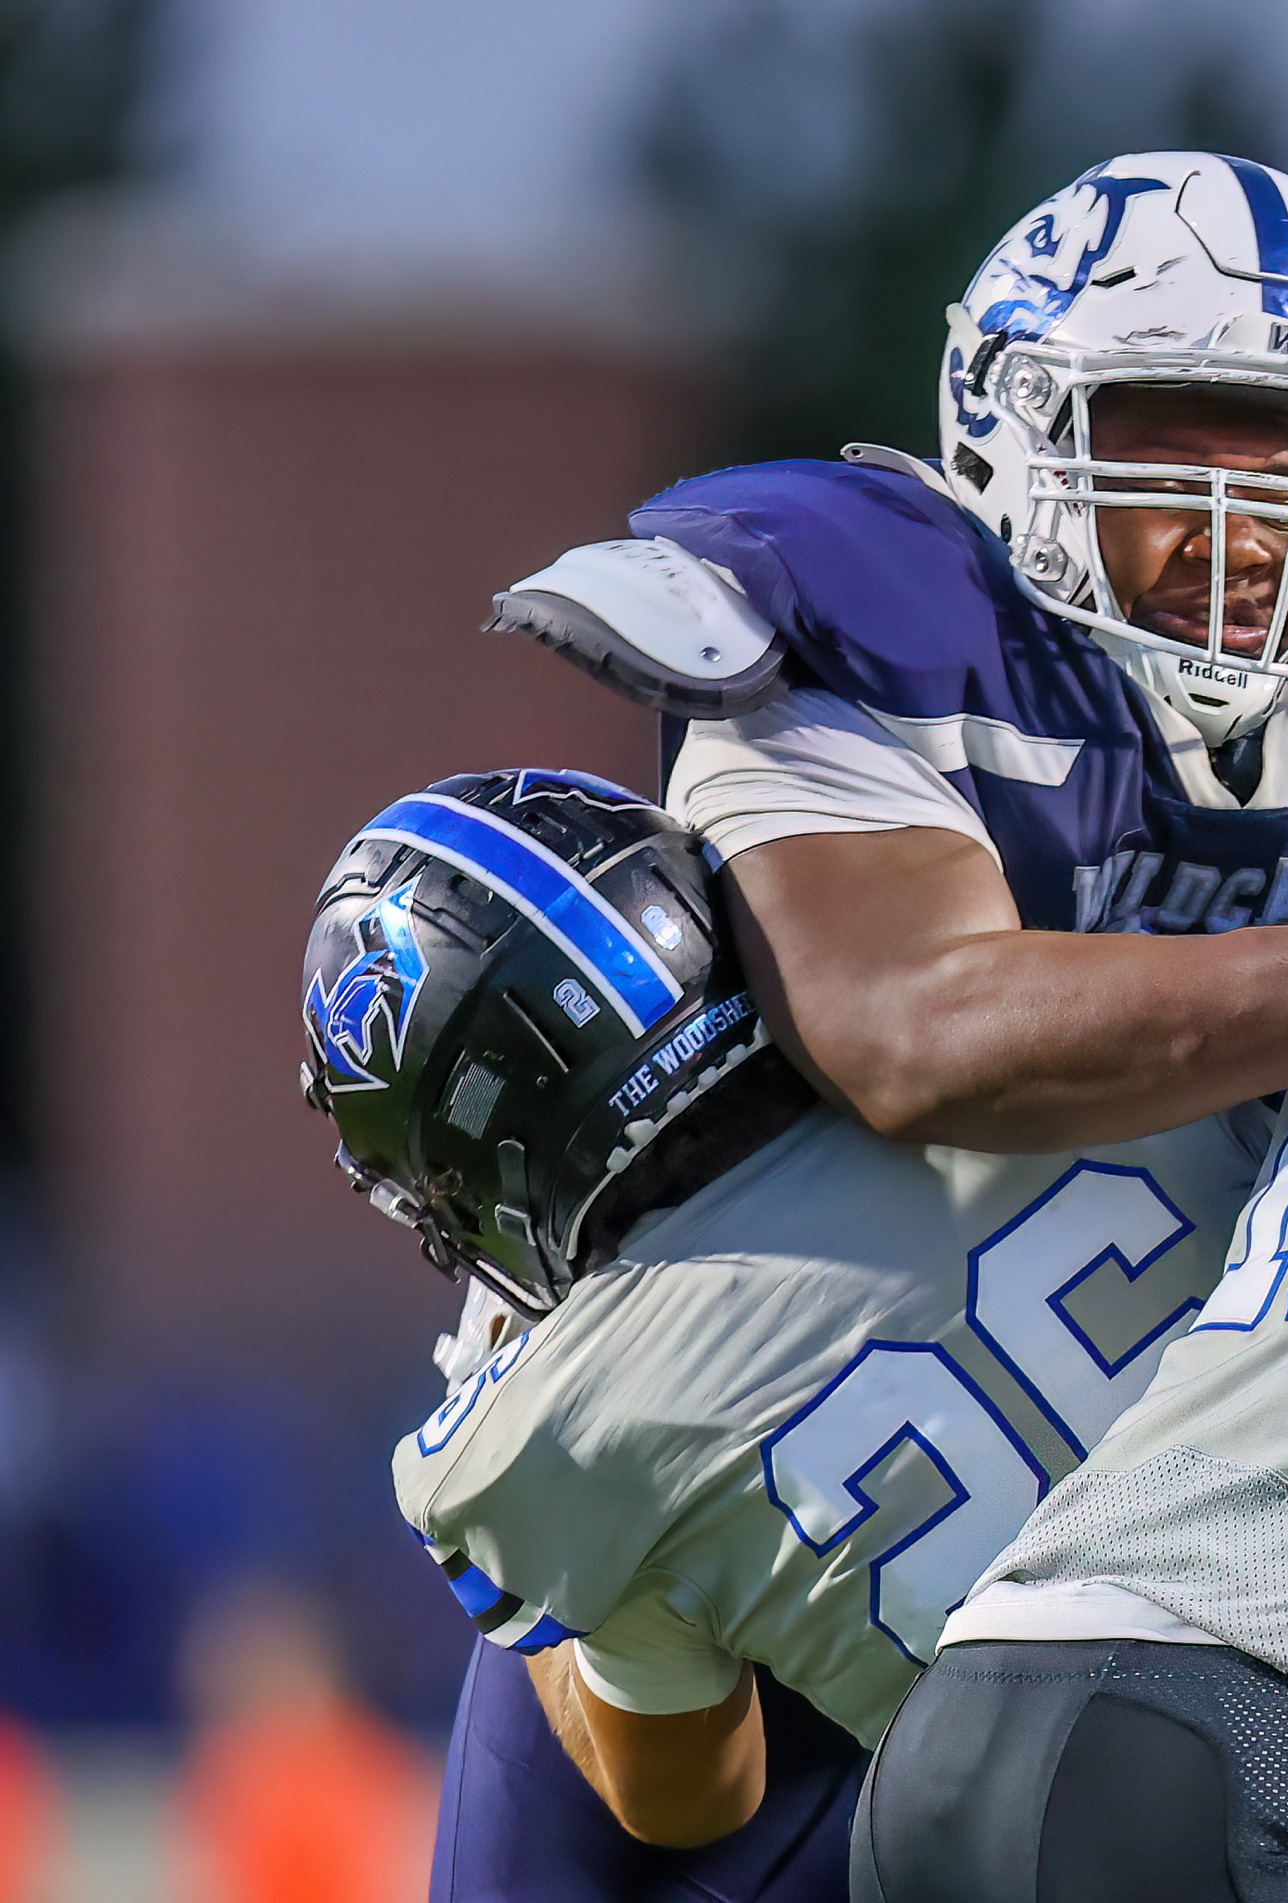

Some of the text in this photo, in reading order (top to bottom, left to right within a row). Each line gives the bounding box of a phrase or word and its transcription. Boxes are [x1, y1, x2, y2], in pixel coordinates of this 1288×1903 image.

[553, 978, 601, 1029] 2
[607, 991, 757, 1117] THE WOODSHE
